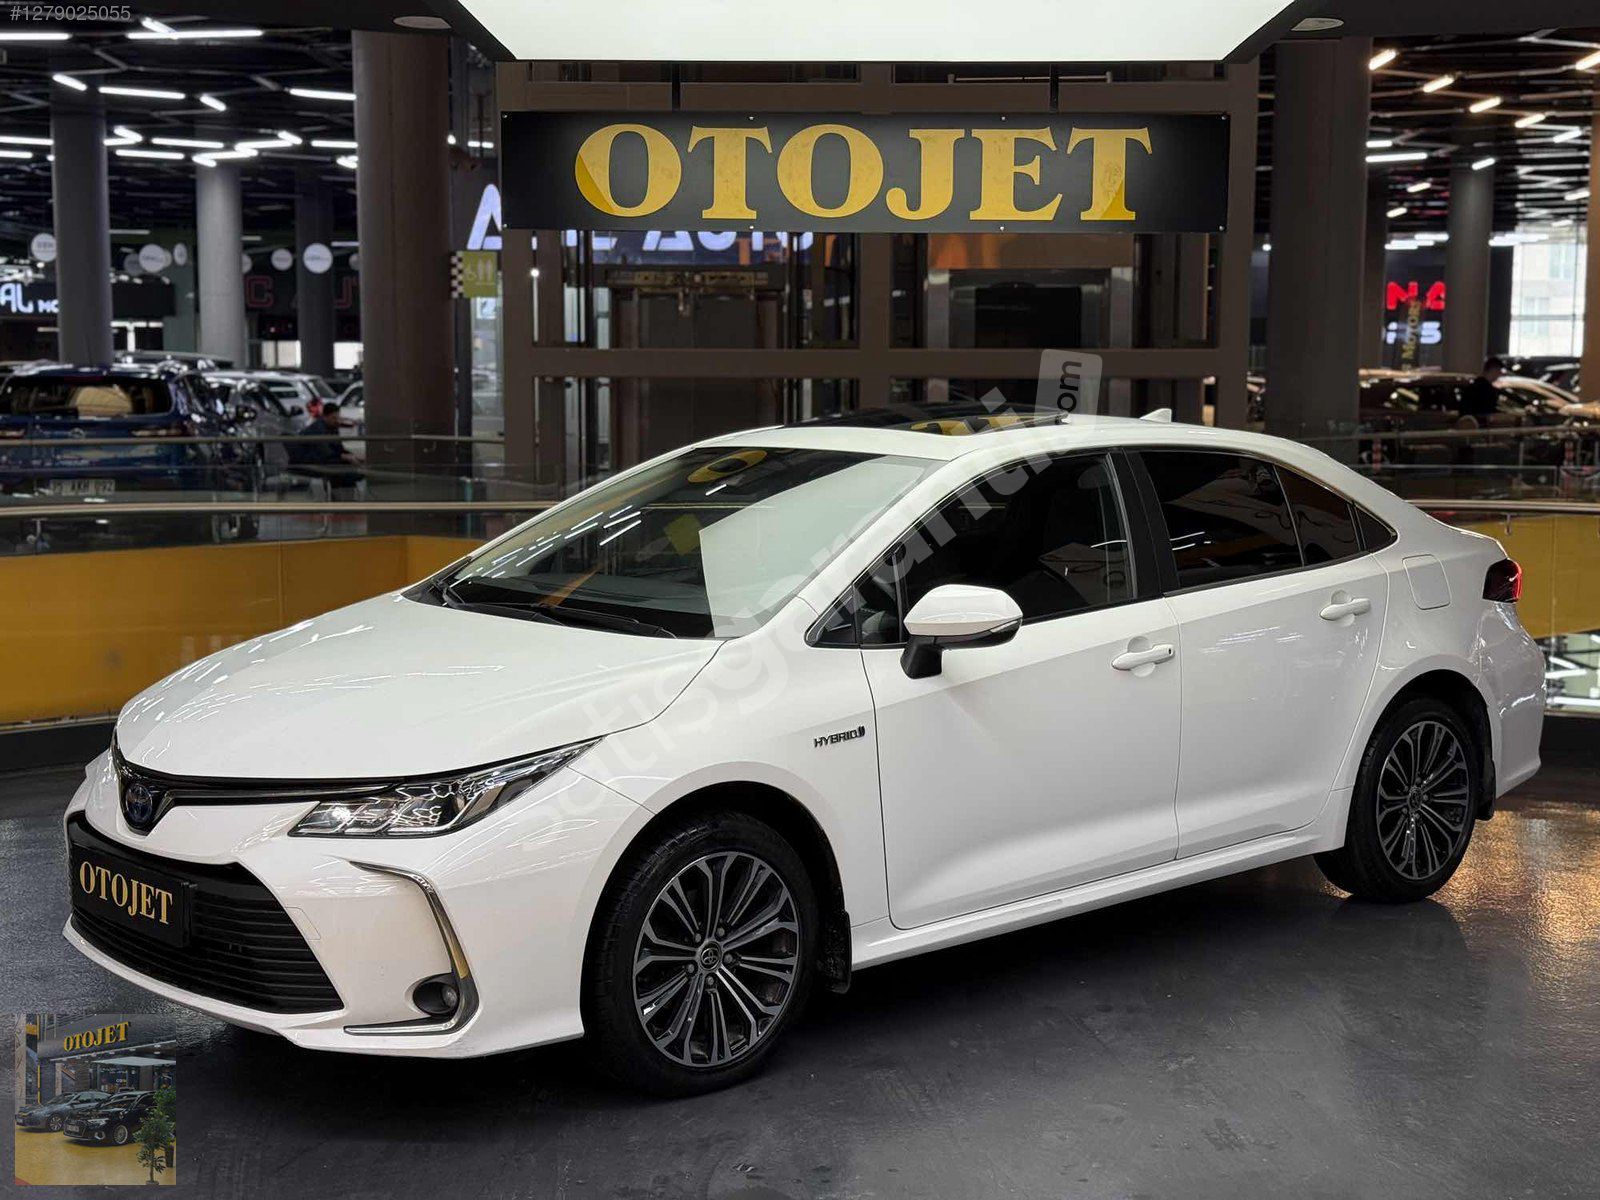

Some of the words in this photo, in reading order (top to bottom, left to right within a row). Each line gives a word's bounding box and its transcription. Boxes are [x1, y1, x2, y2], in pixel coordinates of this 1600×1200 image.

[575, 123, 1153, 221] OTOJET
[814, 729, 858, 748] HYBRID
[80, 861, 173, 925] OTOJET
